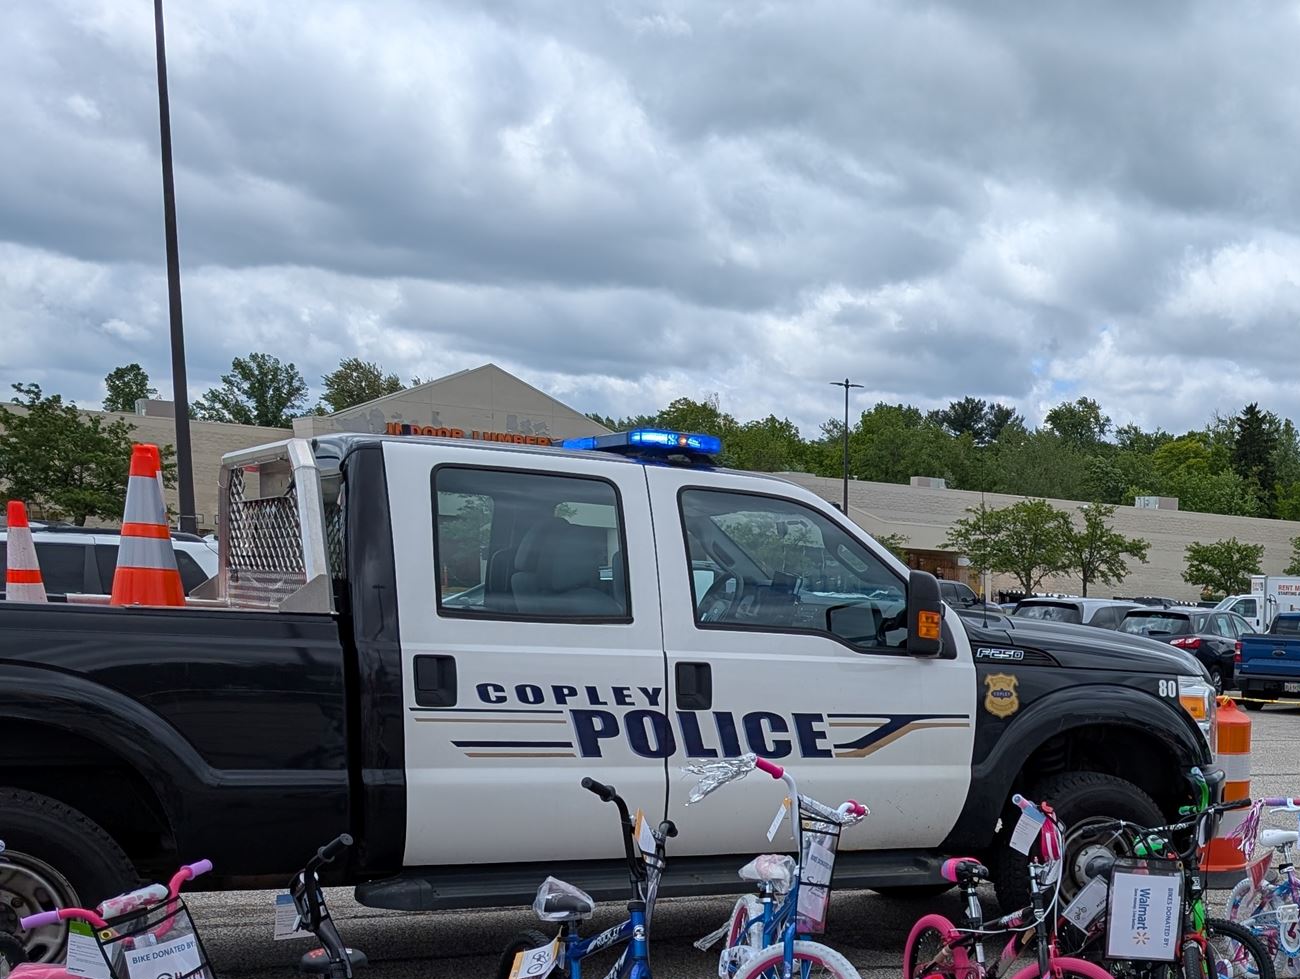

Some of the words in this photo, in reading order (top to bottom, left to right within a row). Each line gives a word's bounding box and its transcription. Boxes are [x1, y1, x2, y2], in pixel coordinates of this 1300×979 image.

[476, 682, 662, 707] COPLEY
[1158, 680, 1176, 697] 80
[569, 709, 834, 759] POLICE
[1136, 888, 1151, 930] Walmart
[1163, 906, 1173, 937] DONATED
[131, 953, 151, 964] BIKE
[152, 943, 186, 960] DONATED
